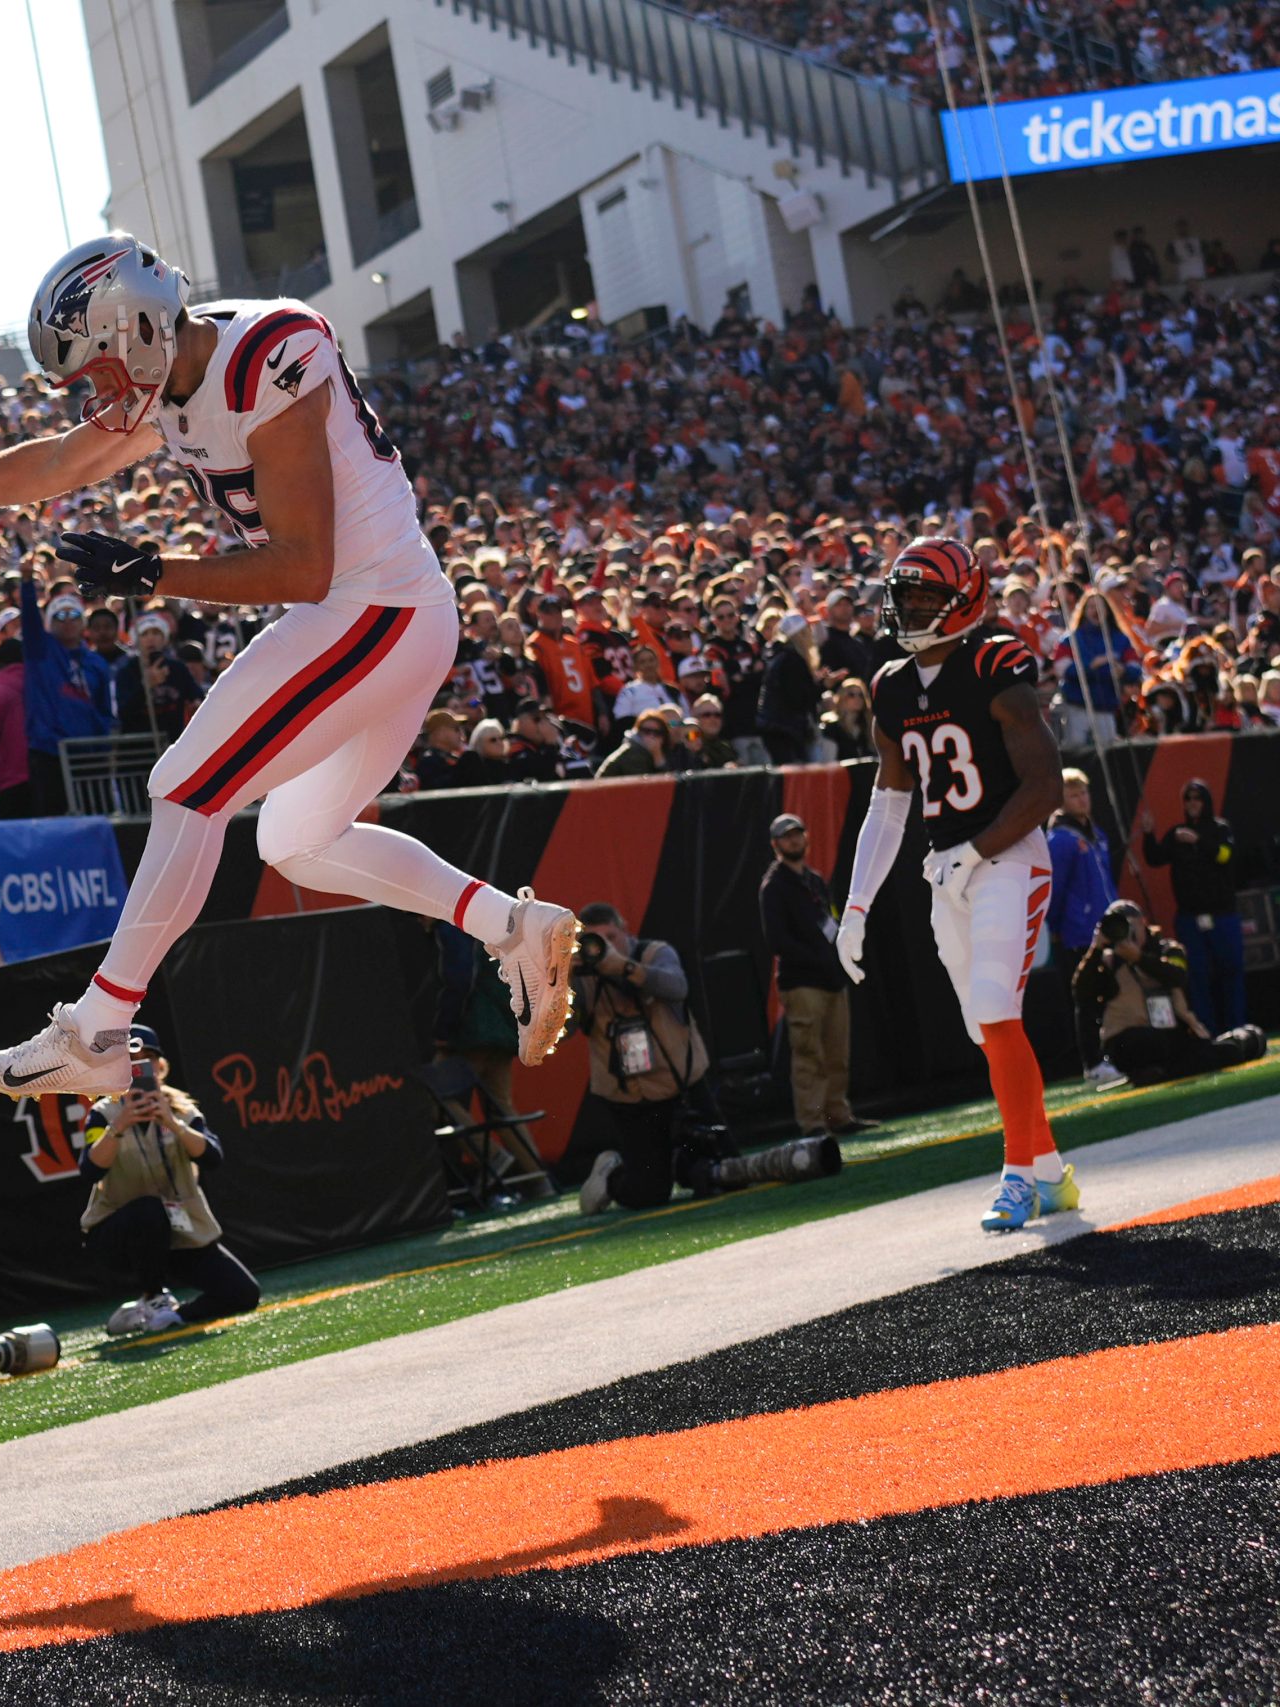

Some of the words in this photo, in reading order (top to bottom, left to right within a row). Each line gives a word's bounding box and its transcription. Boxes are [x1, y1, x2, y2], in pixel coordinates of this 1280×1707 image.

[561, 657, 583, 693] 5
[903, 709, 951, 727] BENGALS
[901, 723, 984, 818] 23
[1, 871, 58, 915] CBS
[67, 868, 118, 909] NFL
